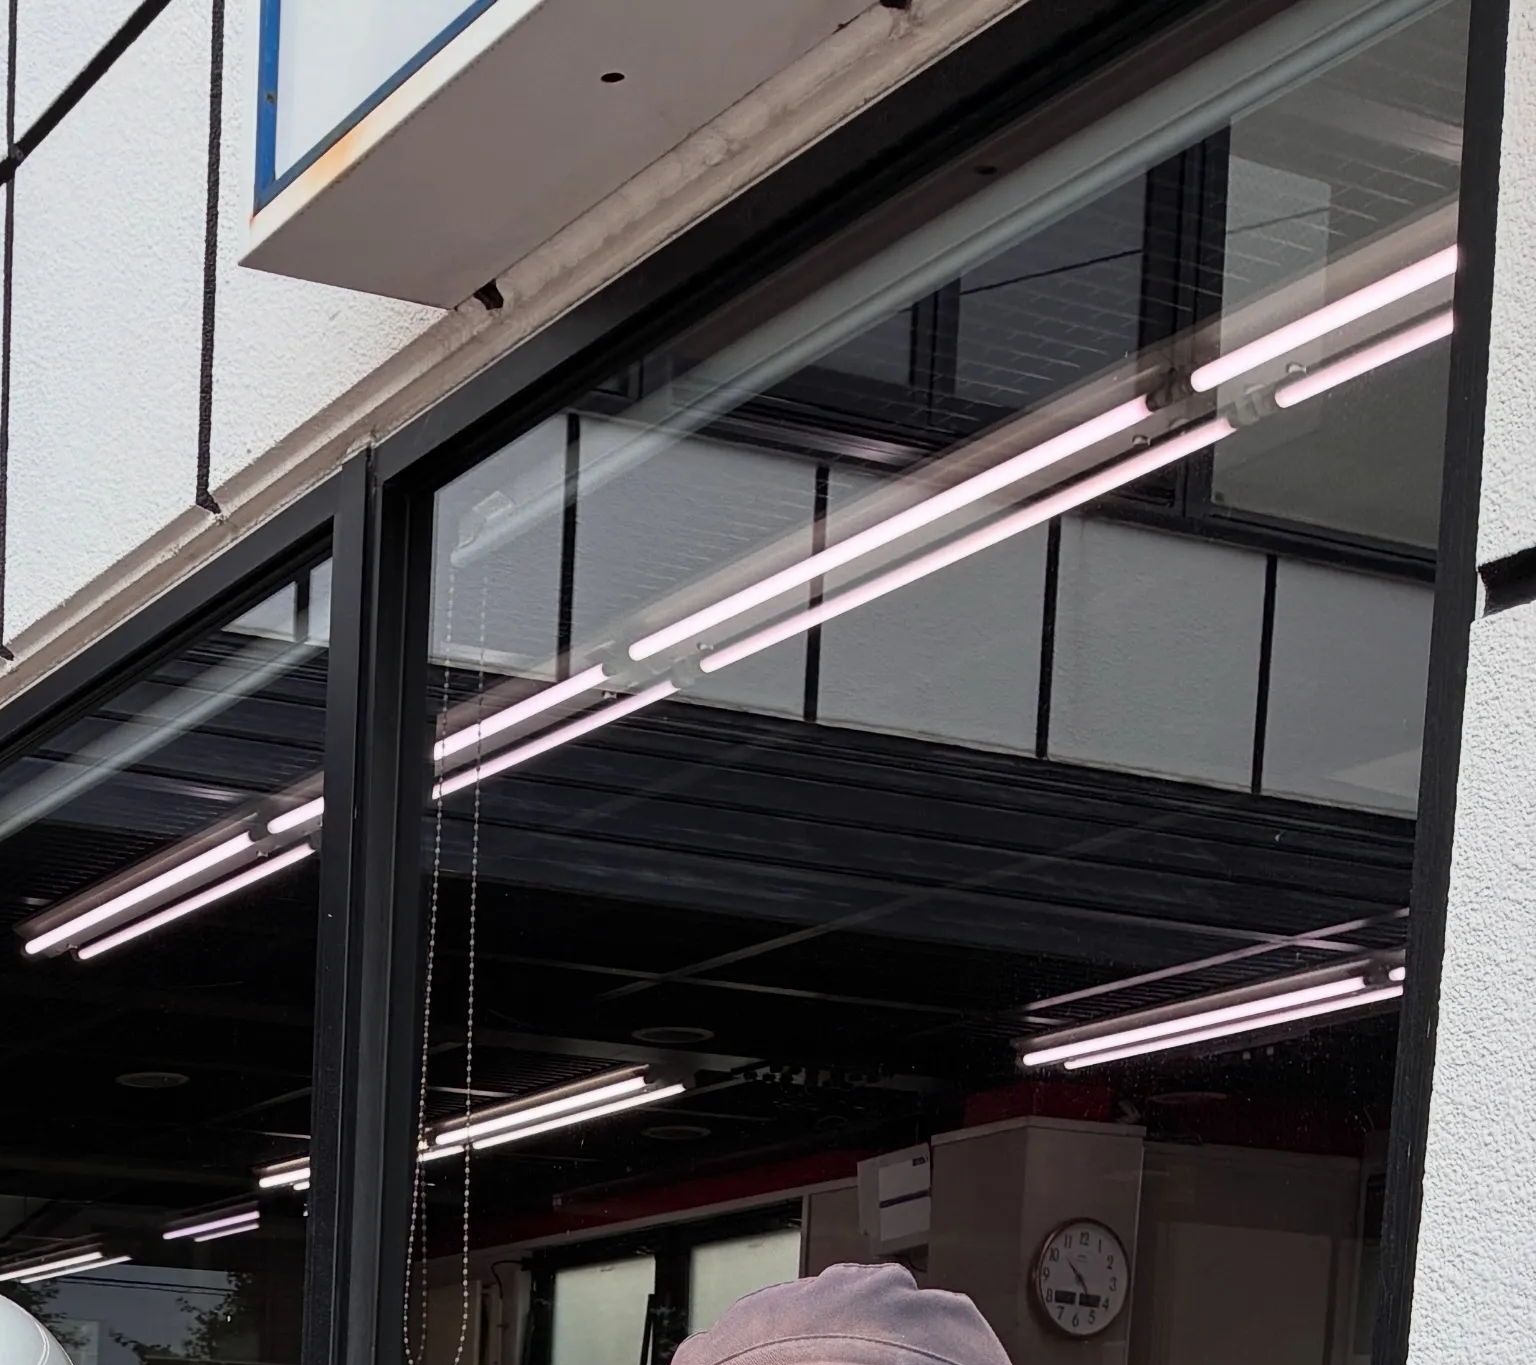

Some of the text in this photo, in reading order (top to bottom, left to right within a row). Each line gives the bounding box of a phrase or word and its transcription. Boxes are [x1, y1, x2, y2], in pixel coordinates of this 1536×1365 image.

[1064, 1234, 1072, 1249] 11
[1079, 1231, 1090, 1246] 12
[1098, 1238, 1102, 1253] 1
[1050, 1247, 1060, 1262] 10
[1106, 1255, 1114, 1270] 2
[1043, 1266, 1050, 1280] 9
[1108, 1276, 1117, 1292] 3
[1045, 1288, 1053, 1303] 8
[1102, 1297, 1109, 1311] 4
[1056, 1304, 1065, 1320] 7
[1072, 1312, 1079, 1327] 6
[1088, 1309, 1096, 1325] 5
